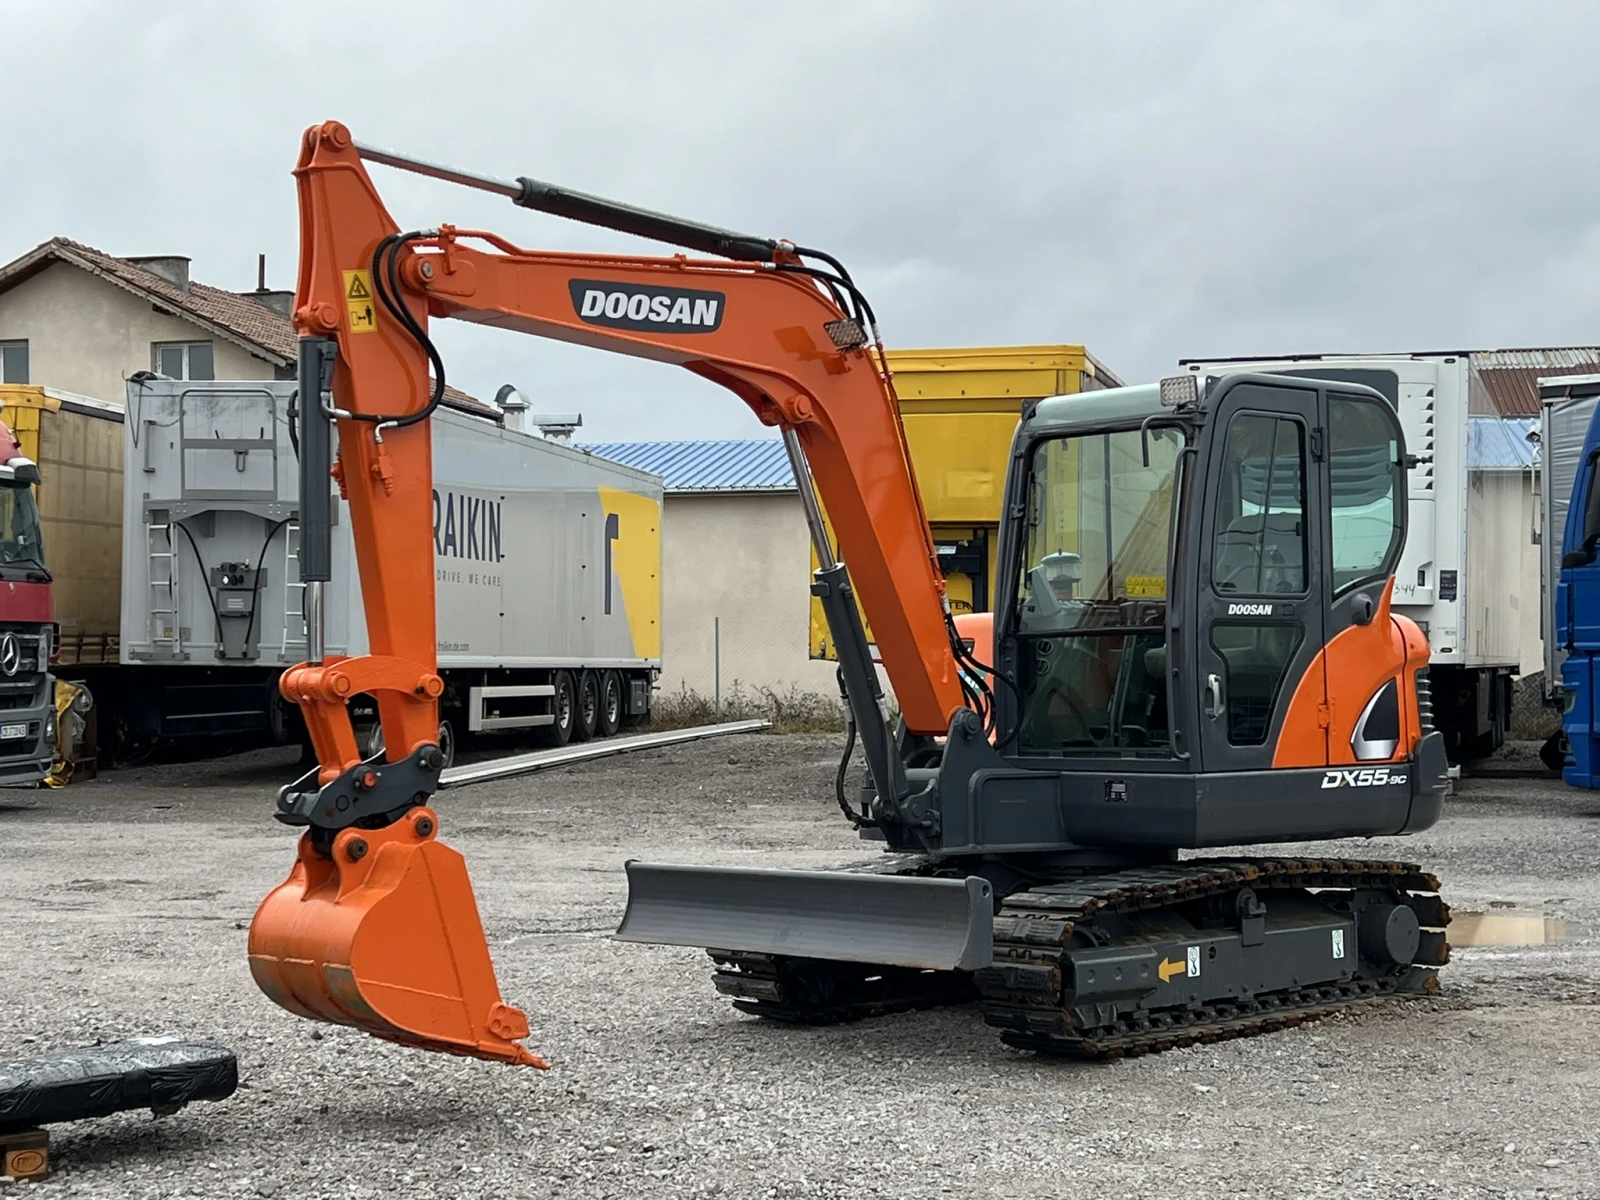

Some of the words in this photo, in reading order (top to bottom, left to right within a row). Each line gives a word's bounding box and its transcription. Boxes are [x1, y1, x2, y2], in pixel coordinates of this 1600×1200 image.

[581, 290, 718, 326] DOOSAN
[468, 573, 479, 585] WE
[1228, 604, 1273, 615] DOOSAN
